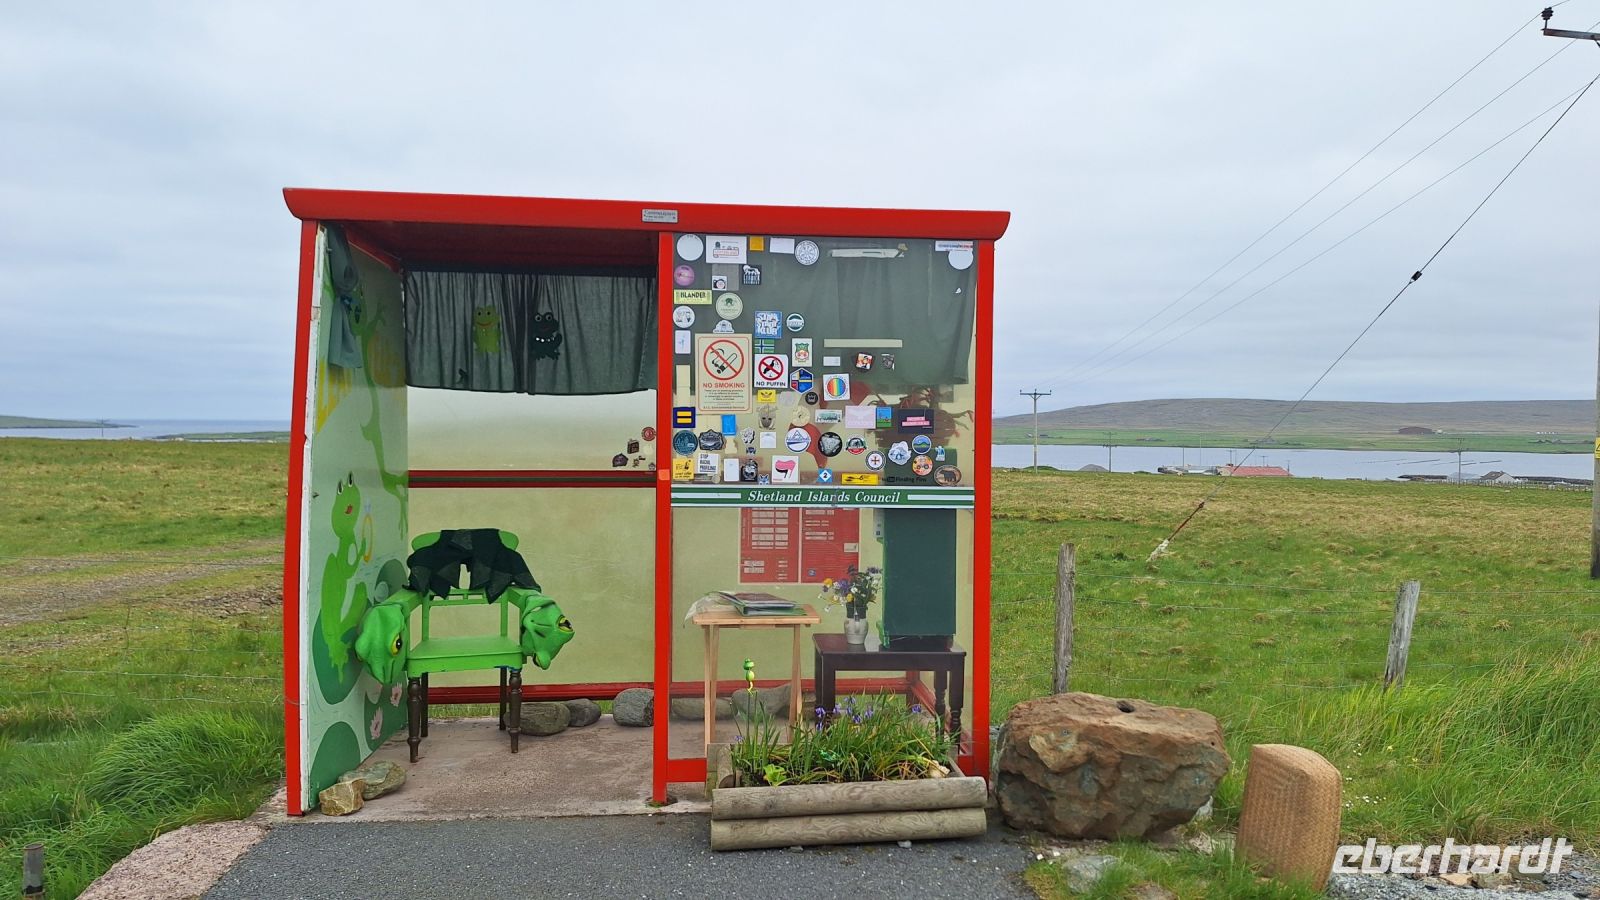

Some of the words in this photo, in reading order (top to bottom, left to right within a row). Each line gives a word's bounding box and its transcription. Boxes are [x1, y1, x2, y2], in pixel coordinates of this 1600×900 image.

[748, 490, 801, 503] Shetland
[807, 490, 850, 503] Islands
[855, 490, 900, 503] Council
